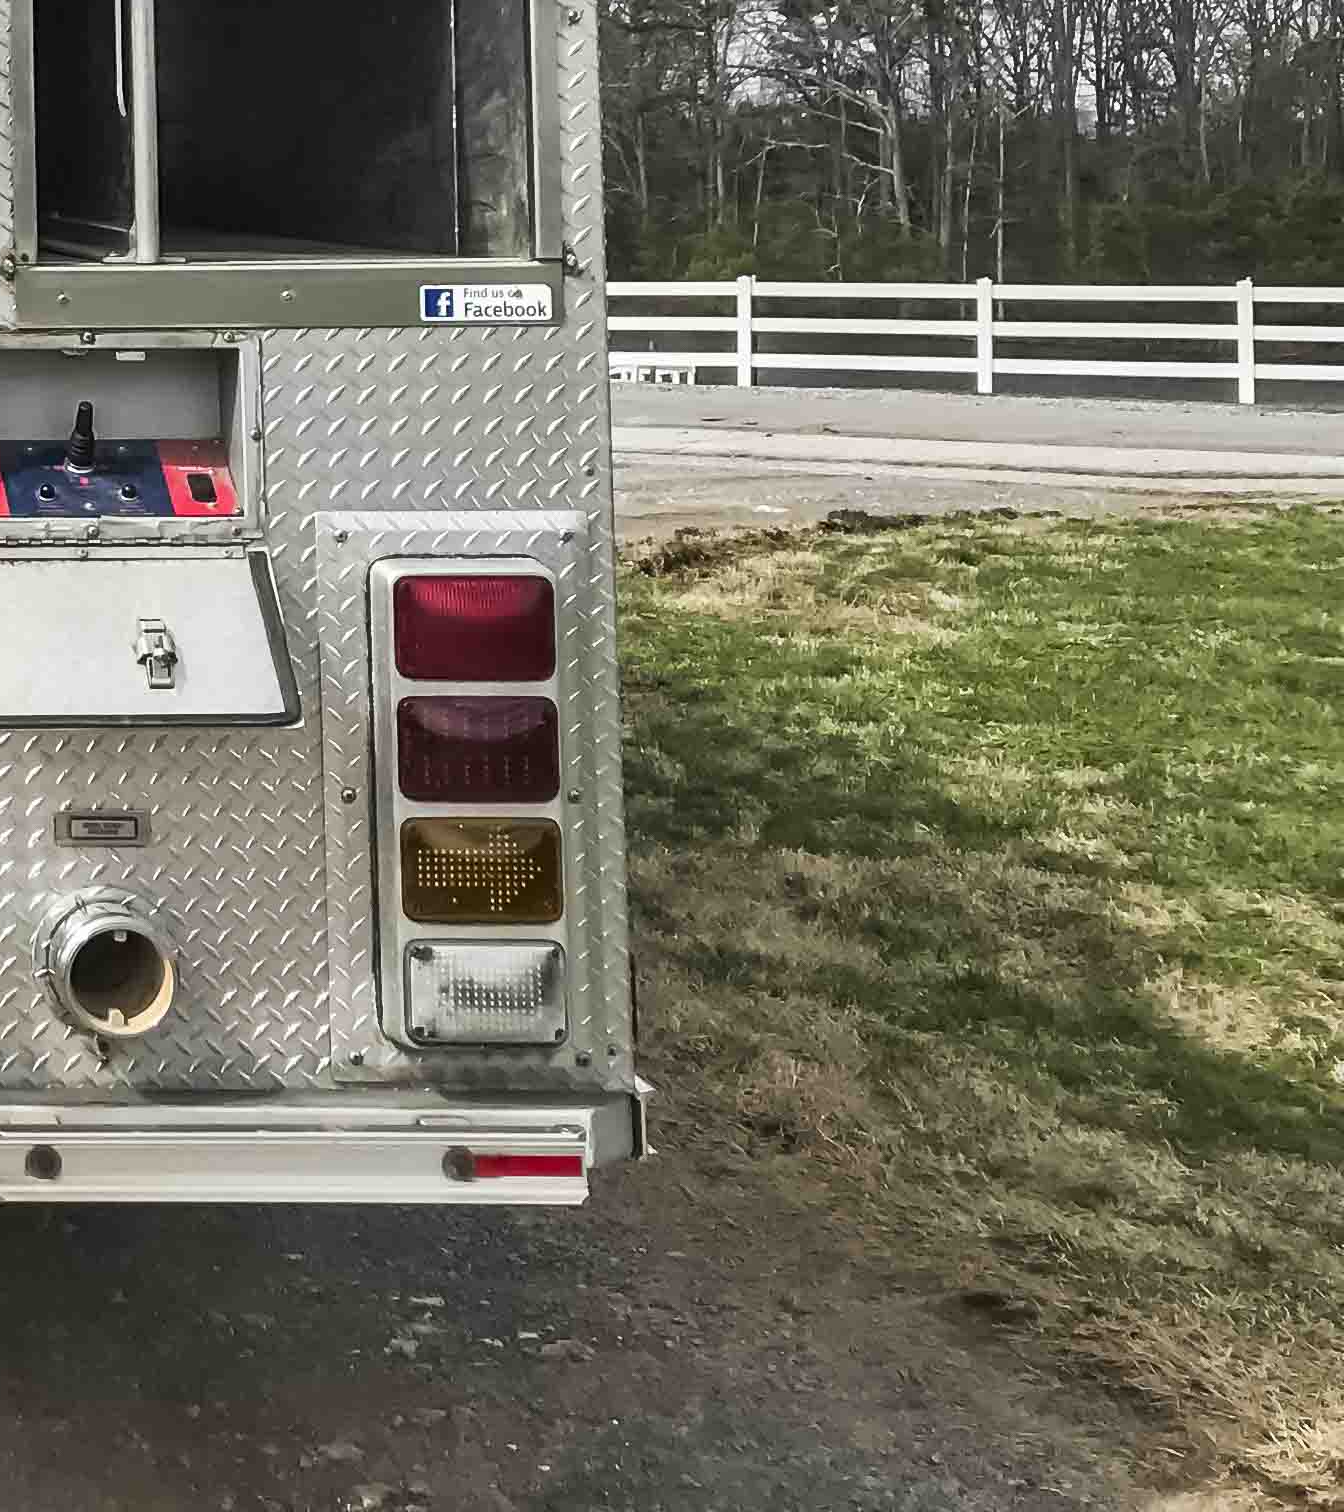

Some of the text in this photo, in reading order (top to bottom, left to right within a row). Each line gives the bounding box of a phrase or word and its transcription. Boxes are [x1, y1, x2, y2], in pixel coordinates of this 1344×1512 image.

[463, 288, 488, 298] Find
[492, 289, 504, 298] us
[464, 301, 547, 317] Facebook
